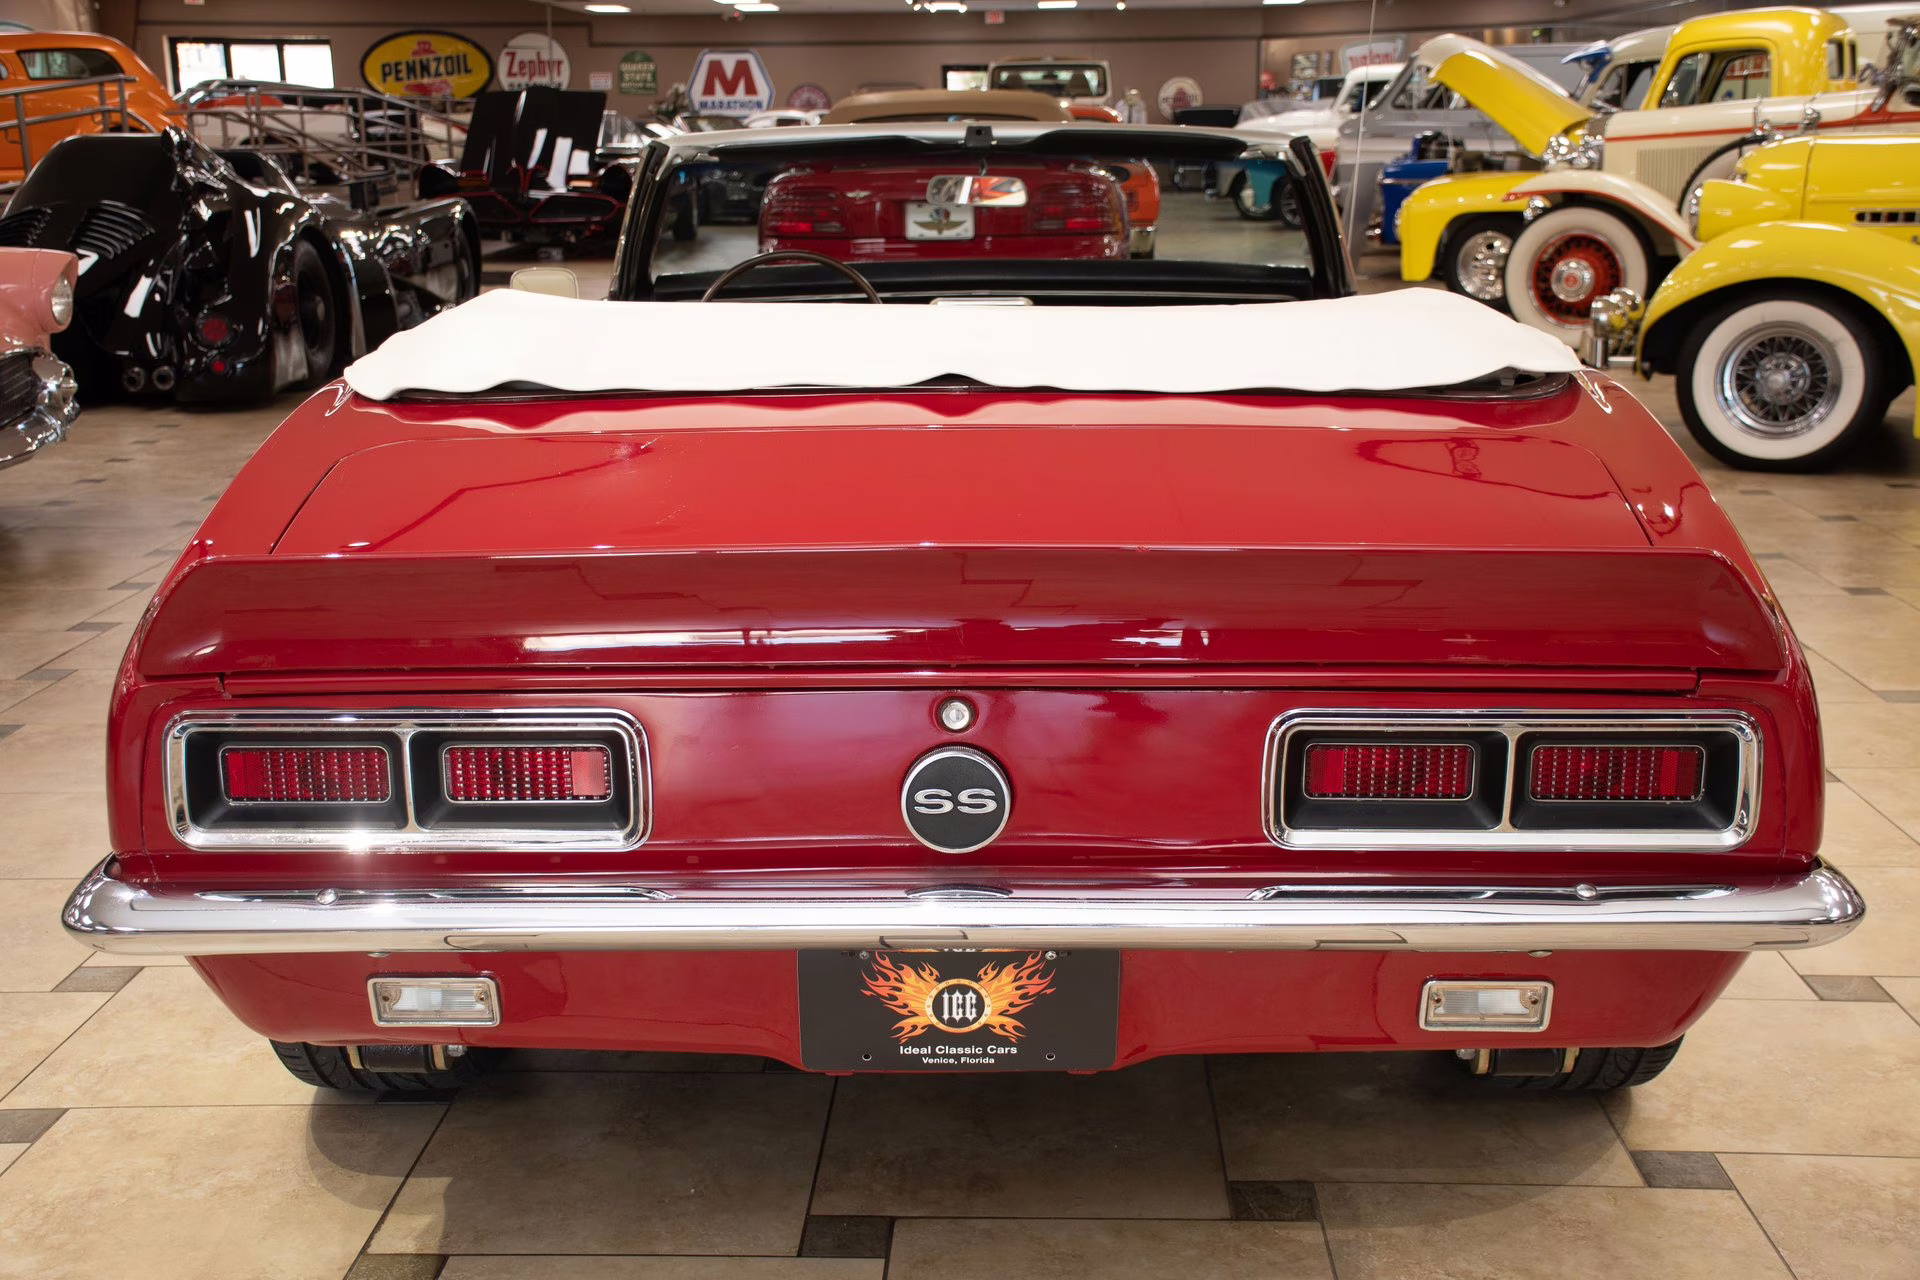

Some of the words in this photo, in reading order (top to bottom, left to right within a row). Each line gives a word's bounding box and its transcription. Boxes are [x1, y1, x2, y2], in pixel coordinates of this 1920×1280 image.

[381, 53, 473, 84] PENNZOIL
[504, 50, 564, 81] Zephyr
[702, 60, 758, 96] M
[700, 100, 762, 110] MARATHON
[914, 788, 998, 814] SS
[900, 1045, 931, 1054] Ideal
[935, 1045, 983, 1054] Classic
[987, 1045, 1018, 1054] Cars
[922, 1057, 957, 1065] Venice,
